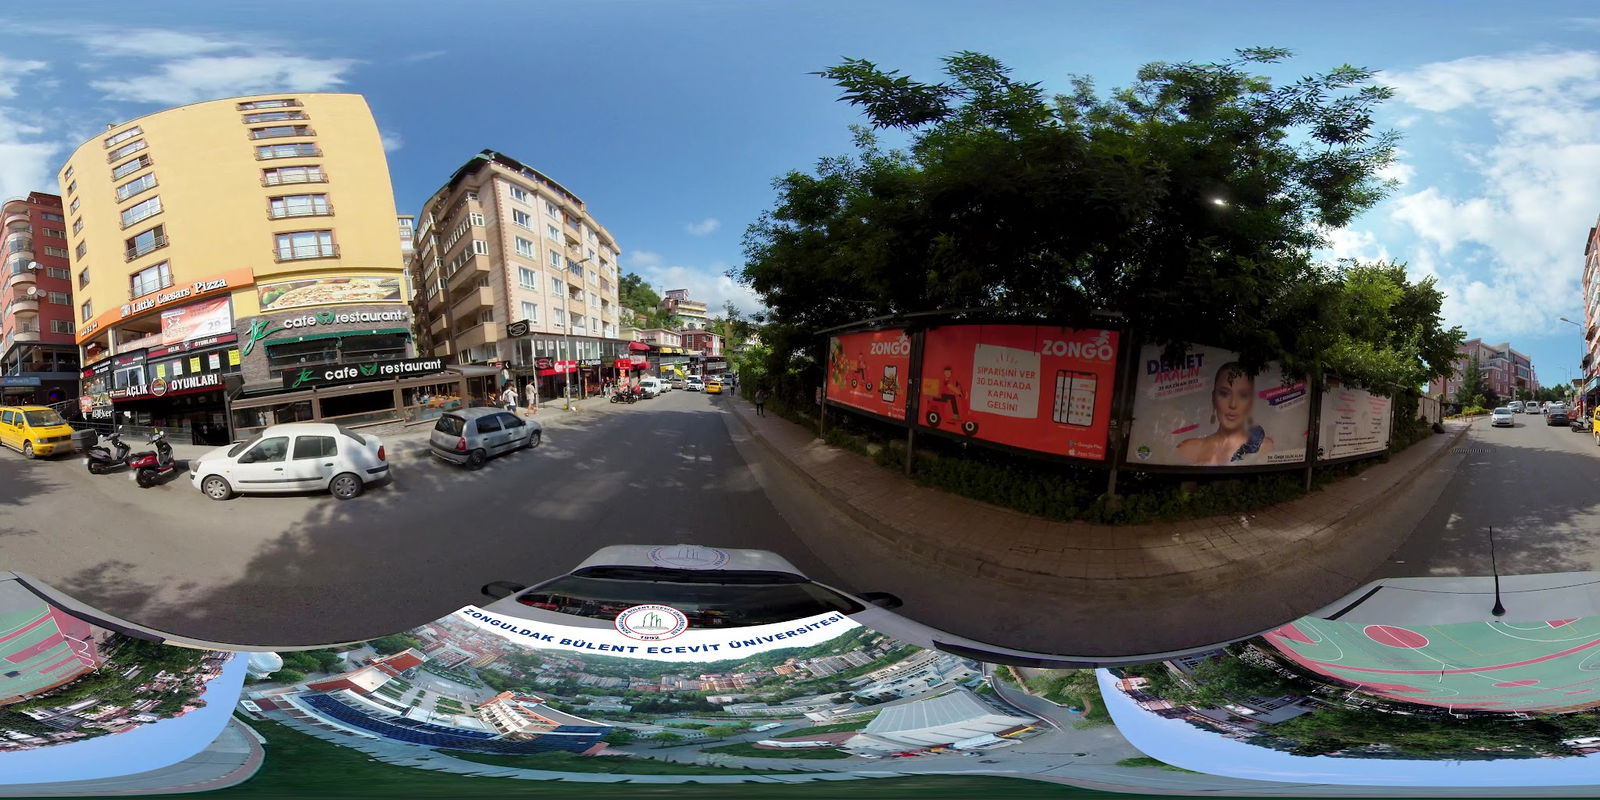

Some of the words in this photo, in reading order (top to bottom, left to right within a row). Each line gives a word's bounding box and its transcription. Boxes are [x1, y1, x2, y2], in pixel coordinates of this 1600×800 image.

[284, 315, 316, 329] cafe
[335, 310, 402, 324] restaurant
[870, 341, 911, 355] ZONGO
[1041, 339, 1113, 361] ZONGO
[325, 366, 359, 381] cafe
[380, 359, 441, 374] restaurant
[1019, 370, 1036, 379] VER
[126, 384, 148, 397] AÇLIK
[171, 373, 218, 391] OYUNLARI
[463, 608, 556, 643] ZONGULDAK
[559, 637, 639, 654] BÜLENT
[646, 643, 721, 654] ECEVİT
[728, 613, 846, 650] ÜNİVERSİTESİ
